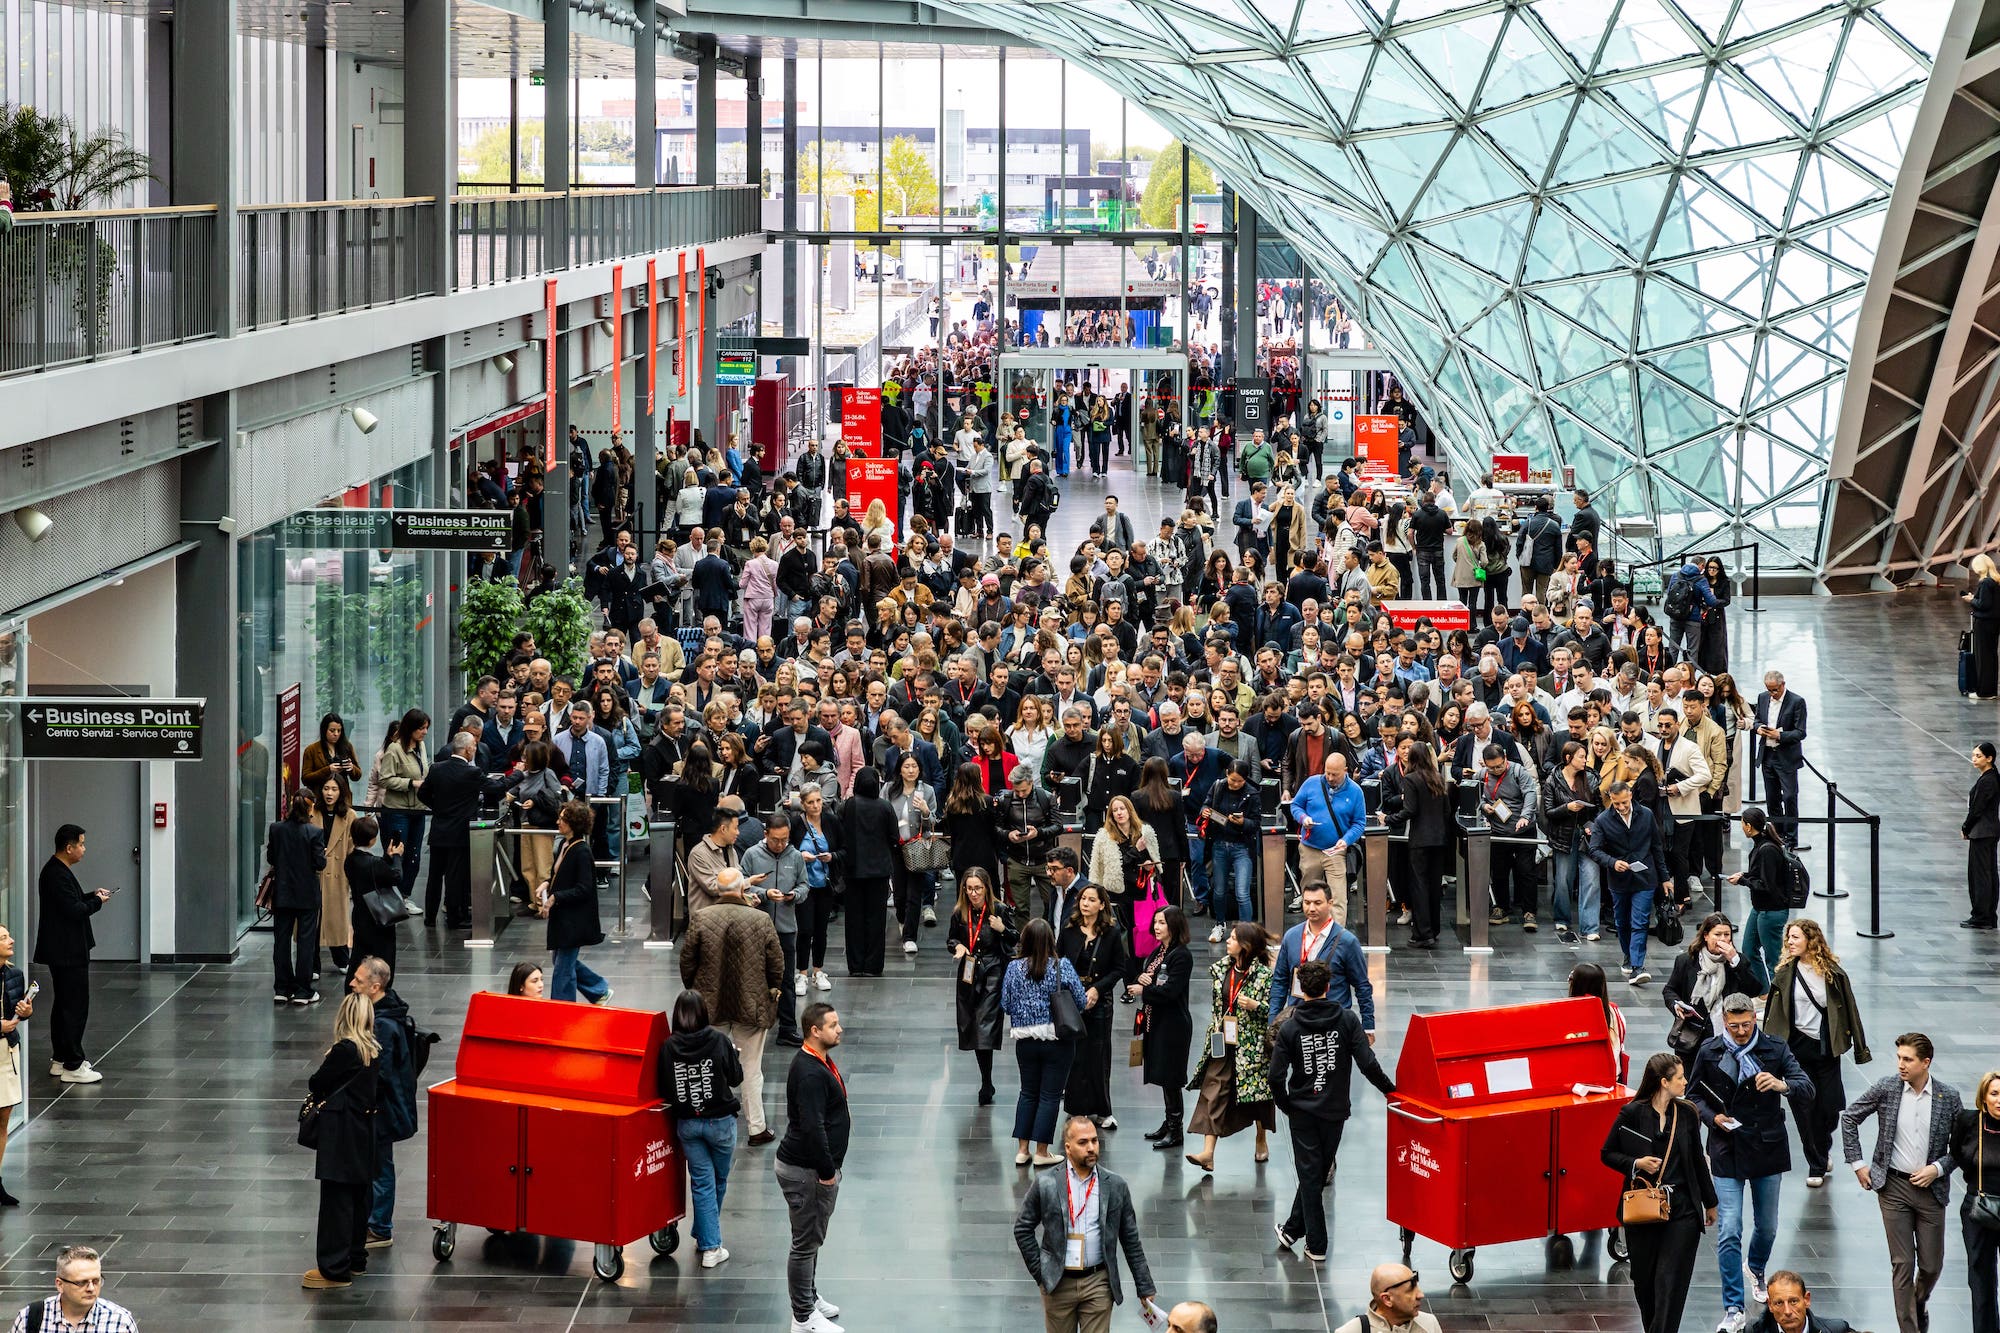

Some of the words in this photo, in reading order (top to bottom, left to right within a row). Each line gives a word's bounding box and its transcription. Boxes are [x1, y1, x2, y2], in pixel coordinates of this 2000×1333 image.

[408, 516, 467, 527] Business
[472, 516, 504, 528] Point
[46, 708, 135, 724] Business
[141, 709, 191, 725] Point
[47, 728, 79, 737] Centro
[82, 728, 114, 737] Servizi
[123, 729, 158, 738] Service
[161, 730, 193, 738] Centre
[1314, 1034, 1326, 1051] del
[1326, 1030, 1339, 1071] Salone
[1300, 1035, 1314, 1074] Milano
[674, 1062, 688, 1102] Milano
[700, 1059, 714, 1099] Salone
[647, 1140, 664, 1153] Salone
[1411, 1140, 1430, 1156] Salone
[647, 1152, 655, 1164] del
[1411, 1151, 1420, 1163] del
[647, 1161, 665, 1176] Milano
[1410, 1161, 1430, 1178] Milano
